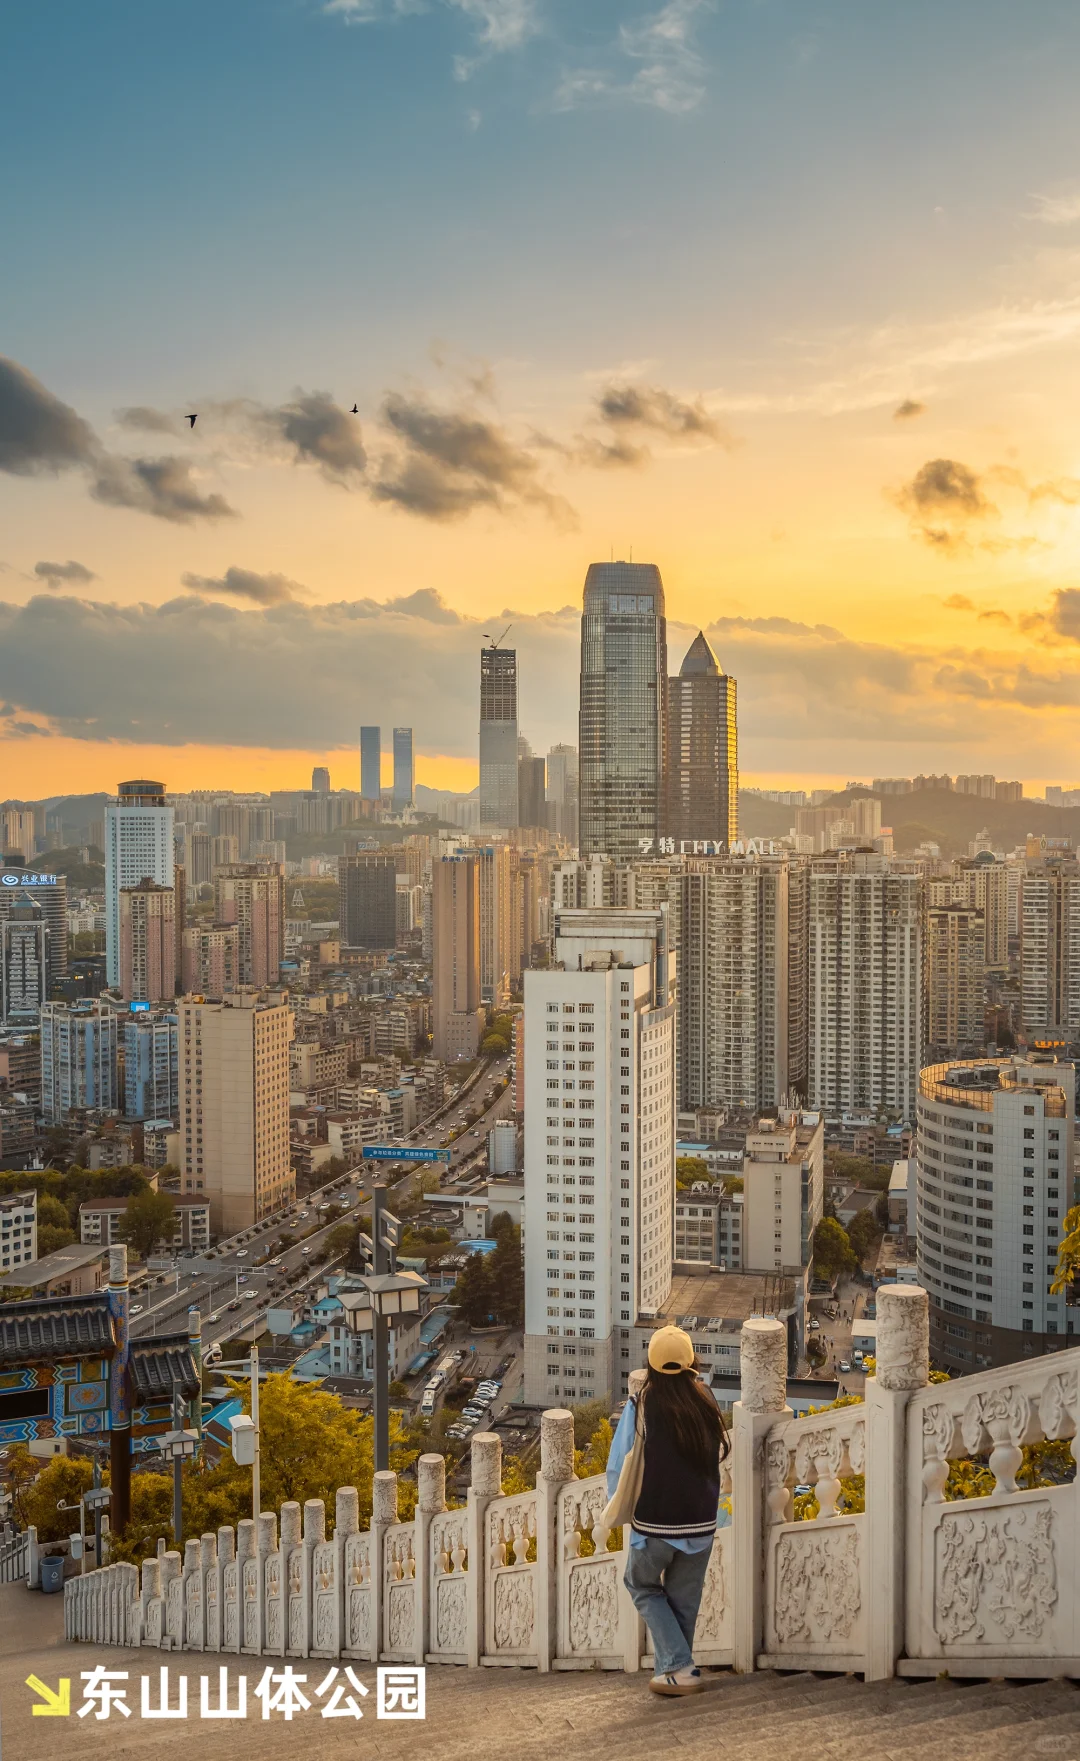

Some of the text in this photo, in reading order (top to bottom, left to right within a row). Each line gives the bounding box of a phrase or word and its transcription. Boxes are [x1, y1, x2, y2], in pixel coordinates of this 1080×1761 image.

[638, 836, 779, 855] 亨特 CITY MALL
[21, 874, 57, 882] 兴业银行
